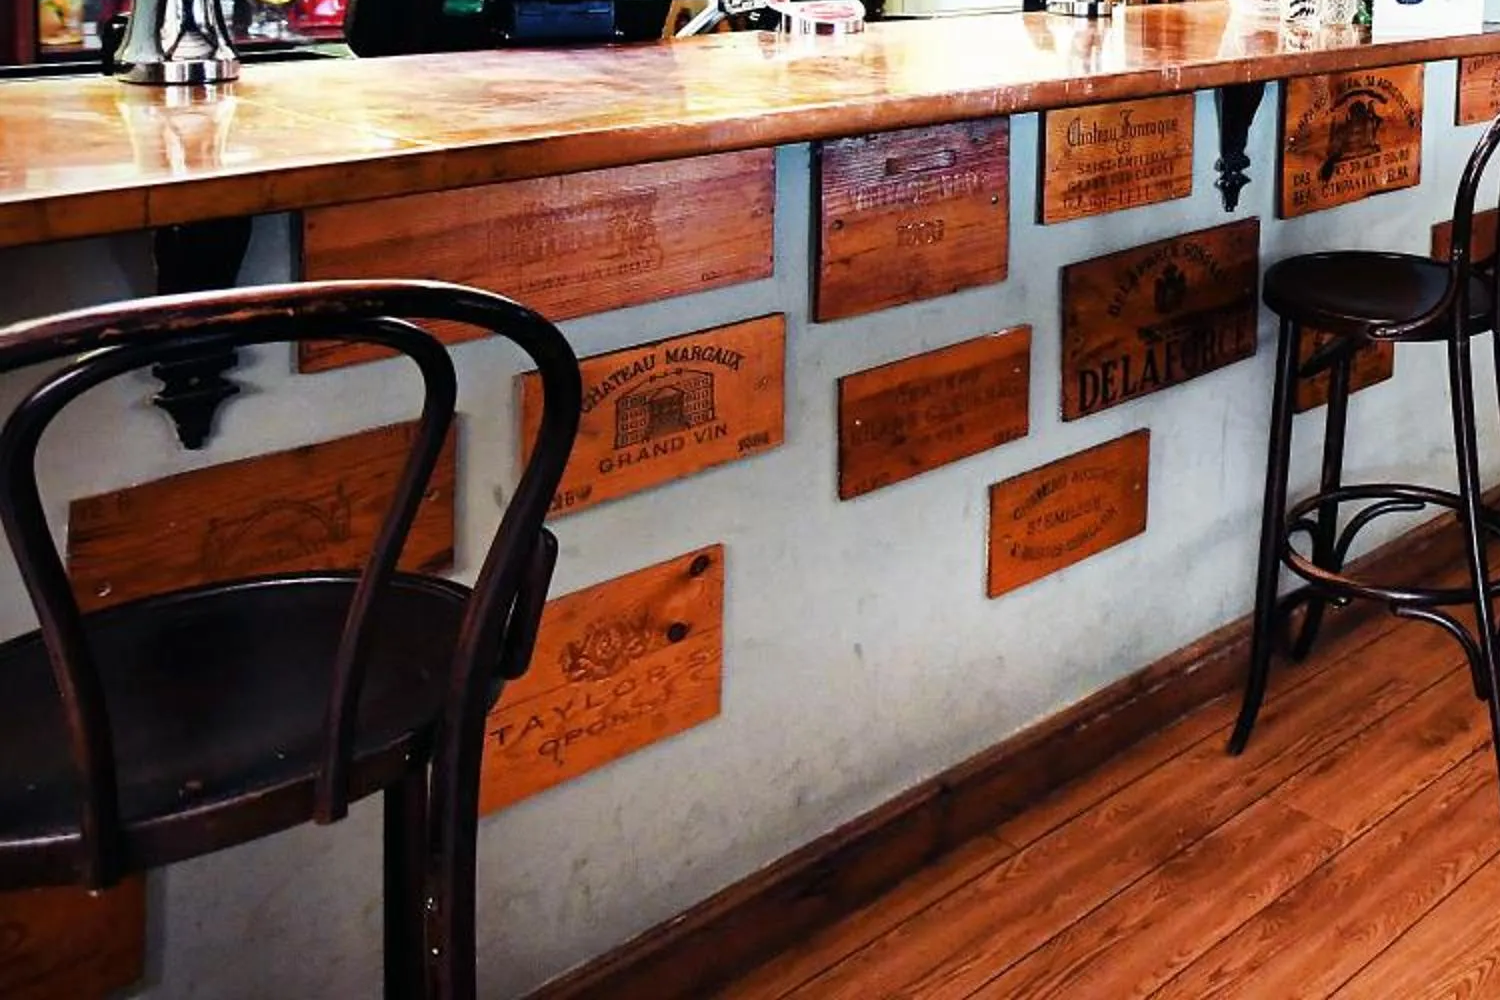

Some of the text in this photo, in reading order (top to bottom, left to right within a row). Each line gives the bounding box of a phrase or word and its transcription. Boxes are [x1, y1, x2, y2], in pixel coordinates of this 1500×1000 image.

[580, 346, 746, 413] CHATEAU MARGAUX
[599, 435, 686, 474] GRAND
[692, 423, 728, 444] VIN
